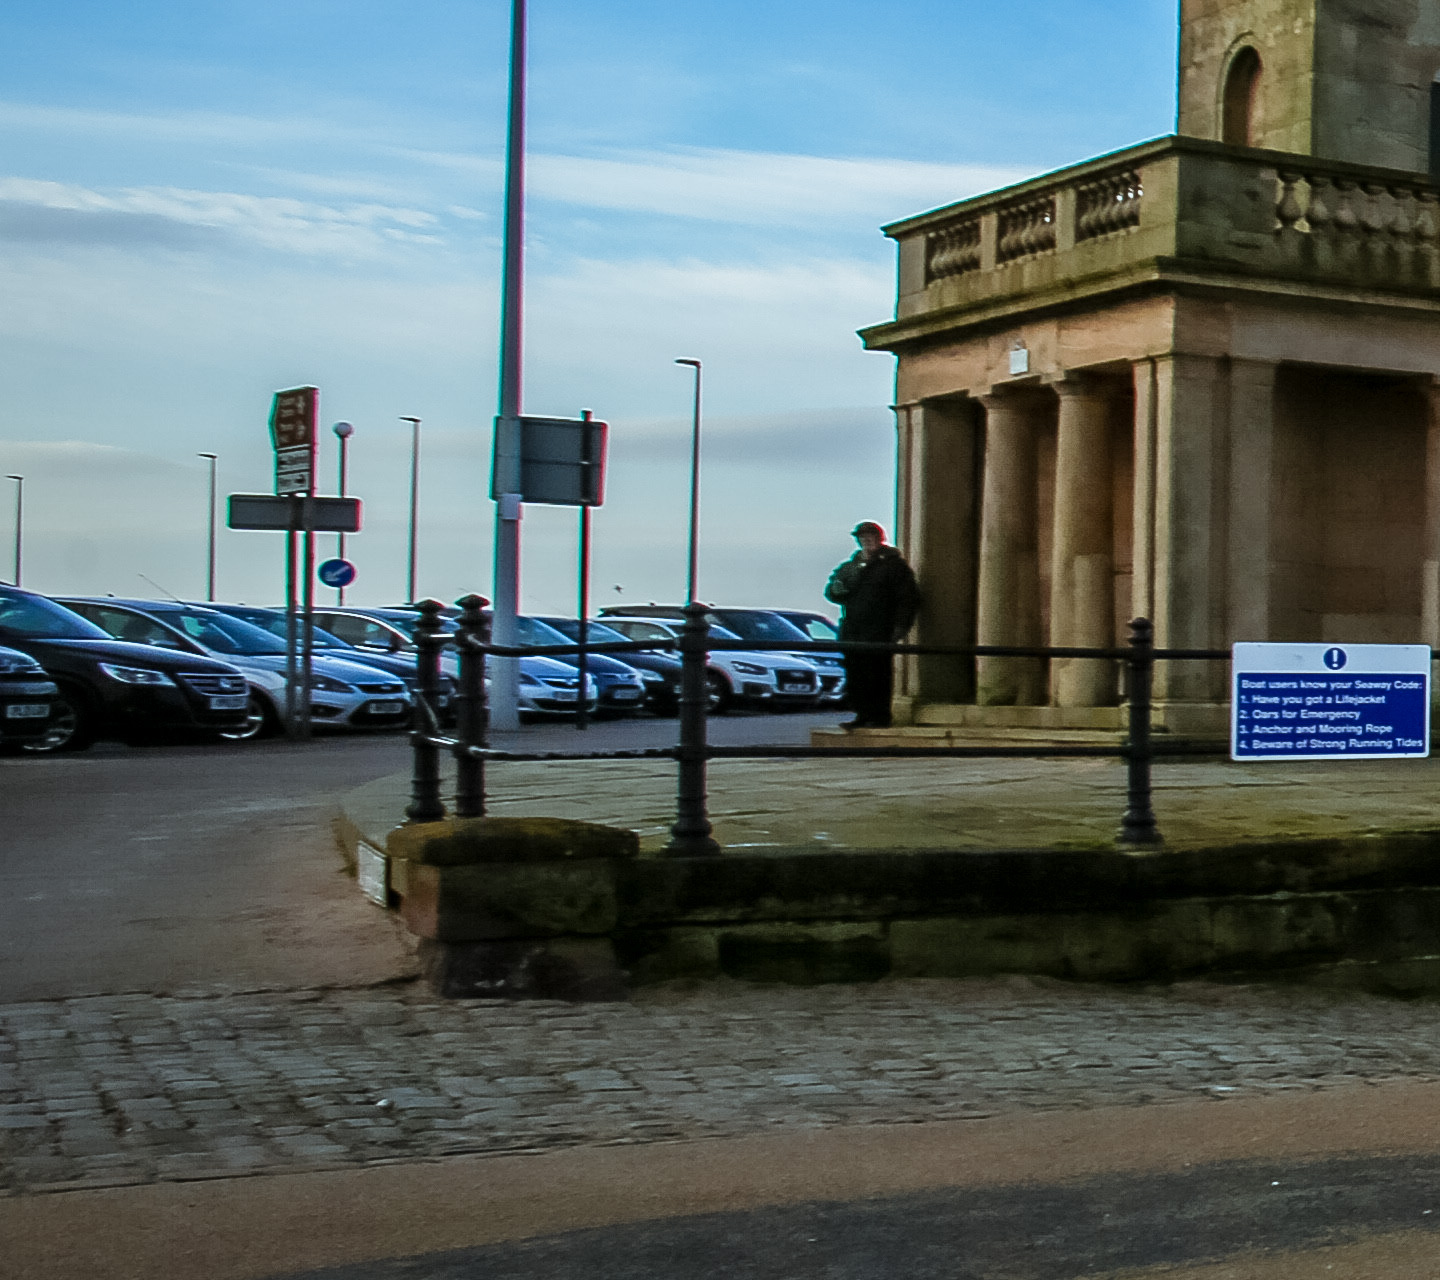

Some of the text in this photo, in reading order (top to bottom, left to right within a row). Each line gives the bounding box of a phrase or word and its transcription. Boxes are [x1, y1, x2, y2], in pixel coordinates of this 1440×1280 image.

[1242, 680, 1266, 688] Boat
[1300, 680, 1327, 688] know
[1330, 682, 1352, 691] your
[1354, 680, 1392, 691] Seaway
[1394, 680, 1423, 689] Code:
[1251, 695, 1280, 704] Have
[1282, 696, 1302, 705] you
[1306, 695, 1323, 706] got
[1326, 696, 1332, 704] a
[1336, 695, 1386, 706] Lifejacket
[1252, 710, 1279, 718] Oars
[1282, 710, 1298, 718] for
[1300, 709, 1361, 720] Emergency
[1252, 724, 1293, 734] Anchor
[1296, 724, 1316, 733] and
[1318, 724, 1362, 735] Mooring
[1366, 724, 1393, 734] Rope
[1252, 739, 1294, 749] Beware
[1296, 739, 1307, 748] of
[1309, 739, 1346, 750] Strong
[1349, 739, 1393, 749] Running
[1396, 738, 1423, 747] Tides
